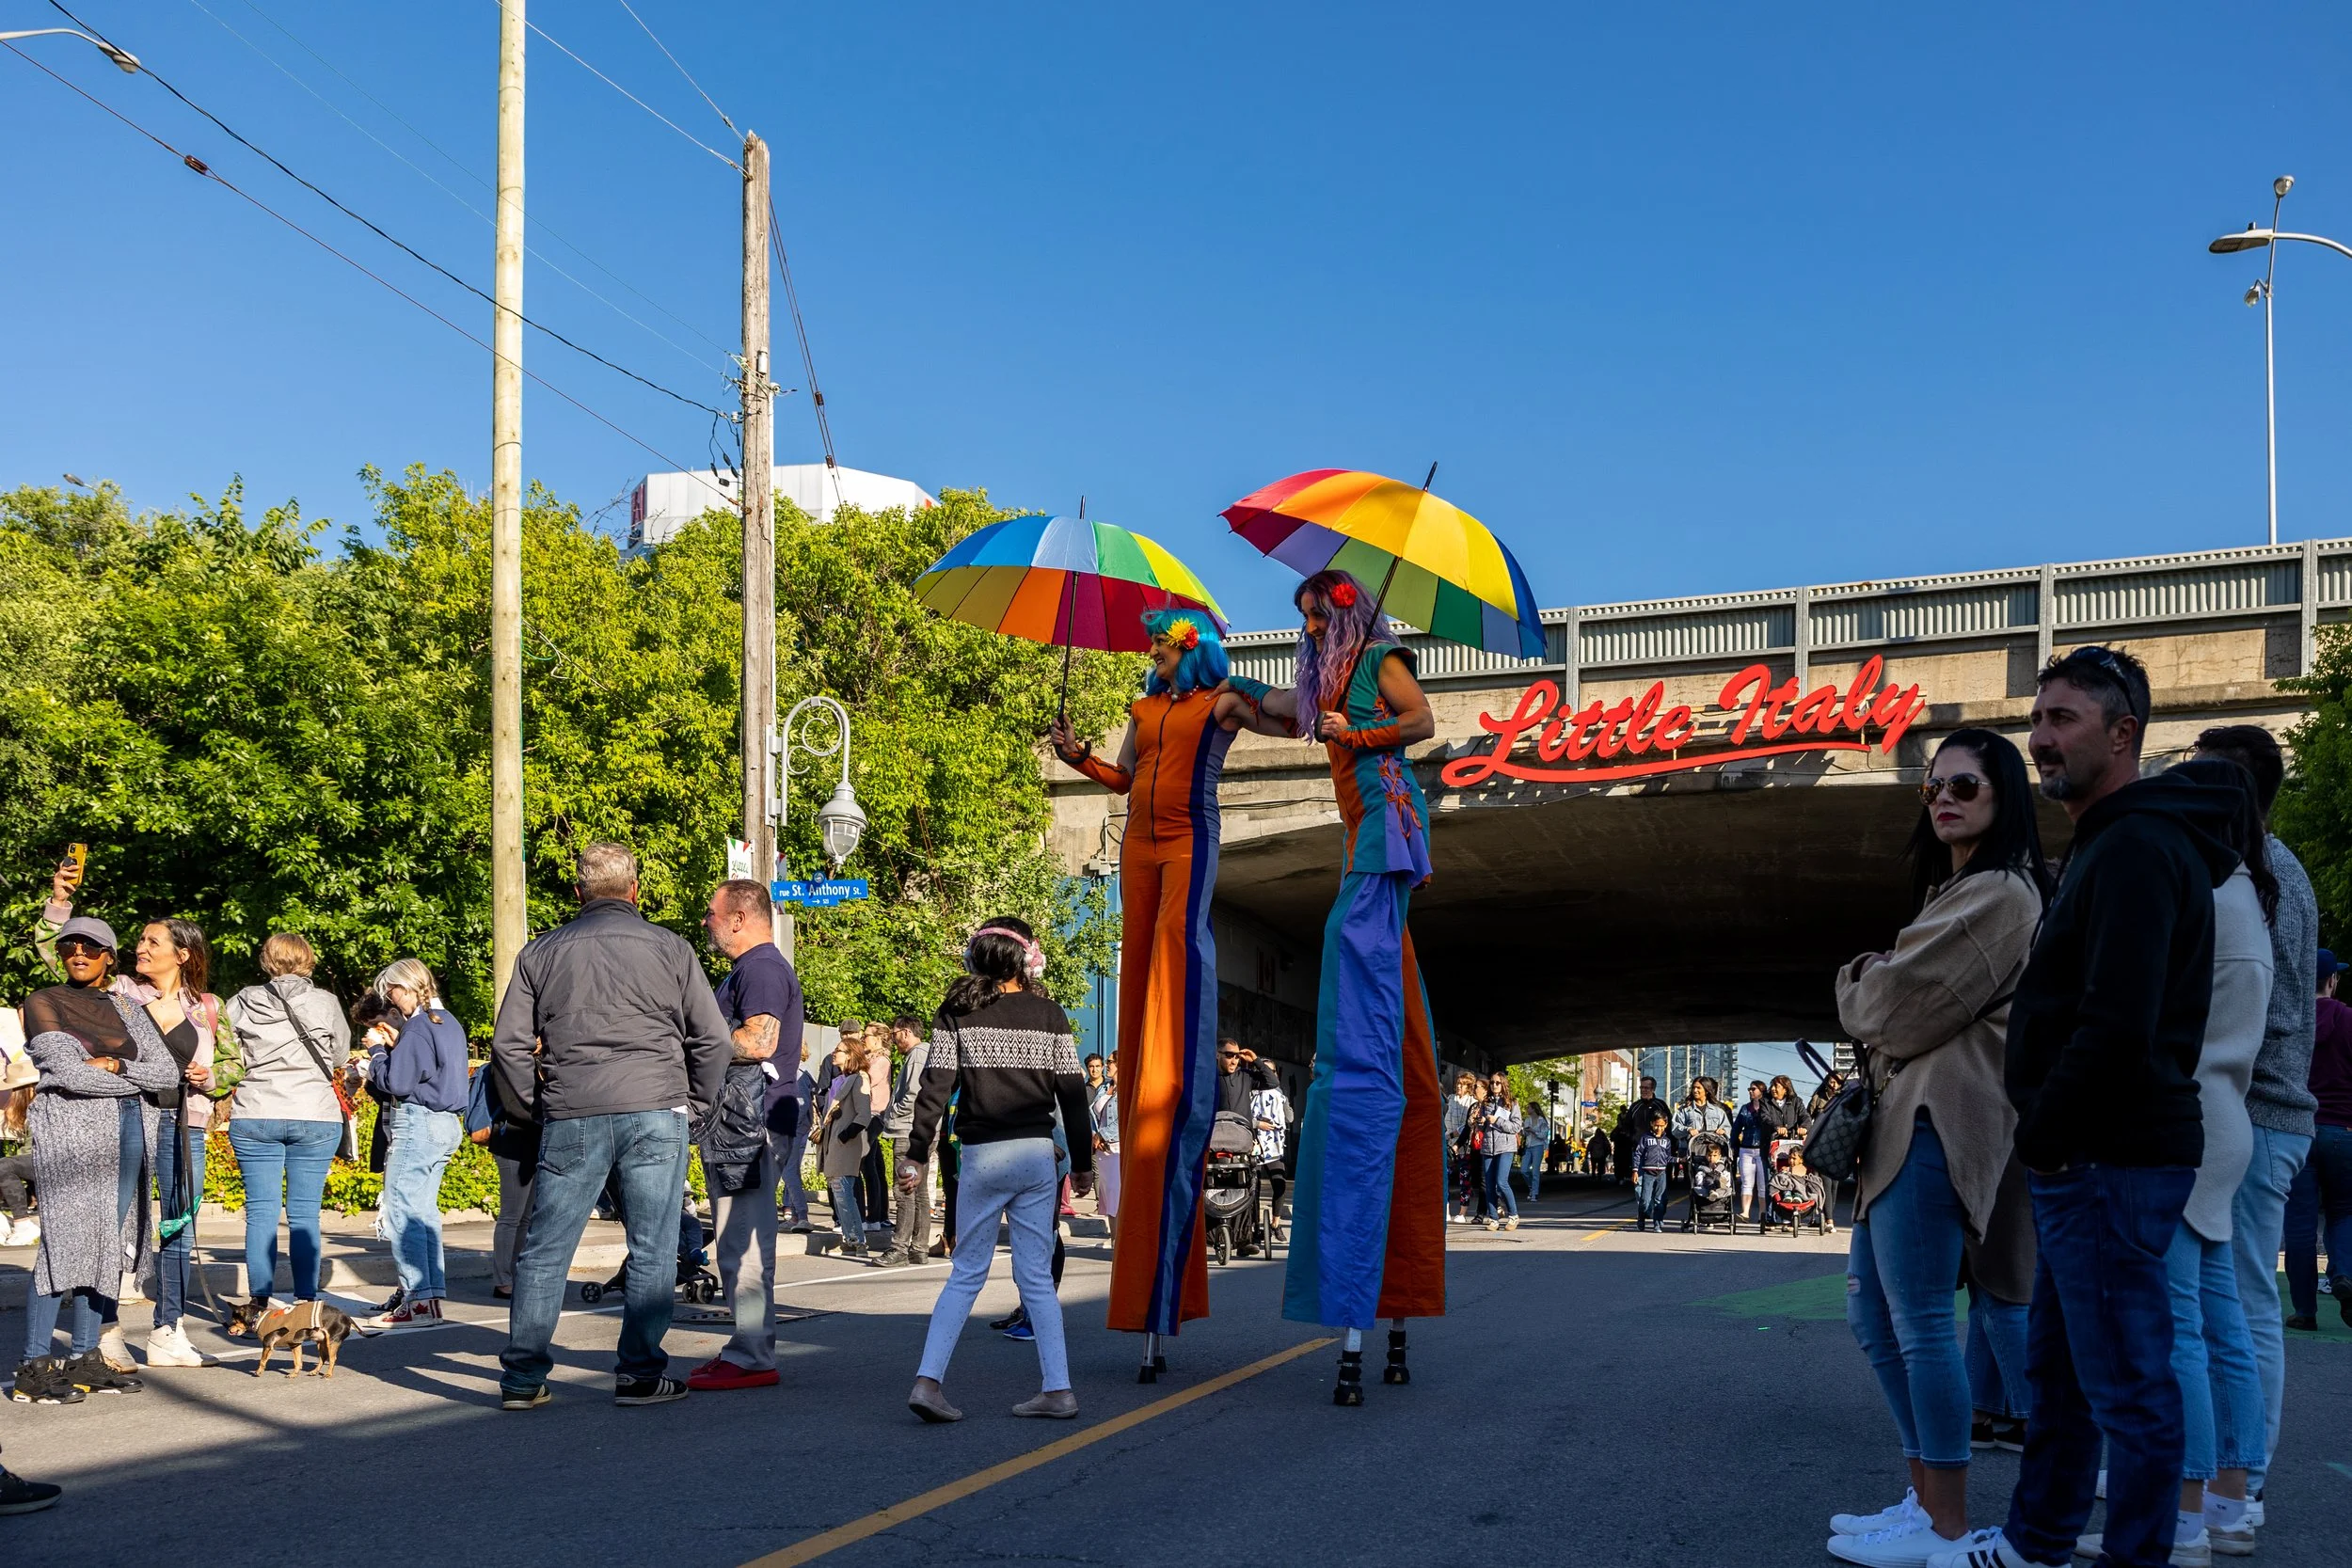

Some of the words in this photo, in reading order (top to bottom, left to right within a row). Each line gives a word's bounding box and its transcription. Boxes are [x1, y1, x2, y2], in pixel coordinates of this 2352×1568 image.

[1441, 679, 1694, 787] Little
[1718, 654, 1926, 754] Italy
[791, 884, 805, 896] St.
[809, 883, 850, 898] Anthony
[852, 886, 862, 895] St.
